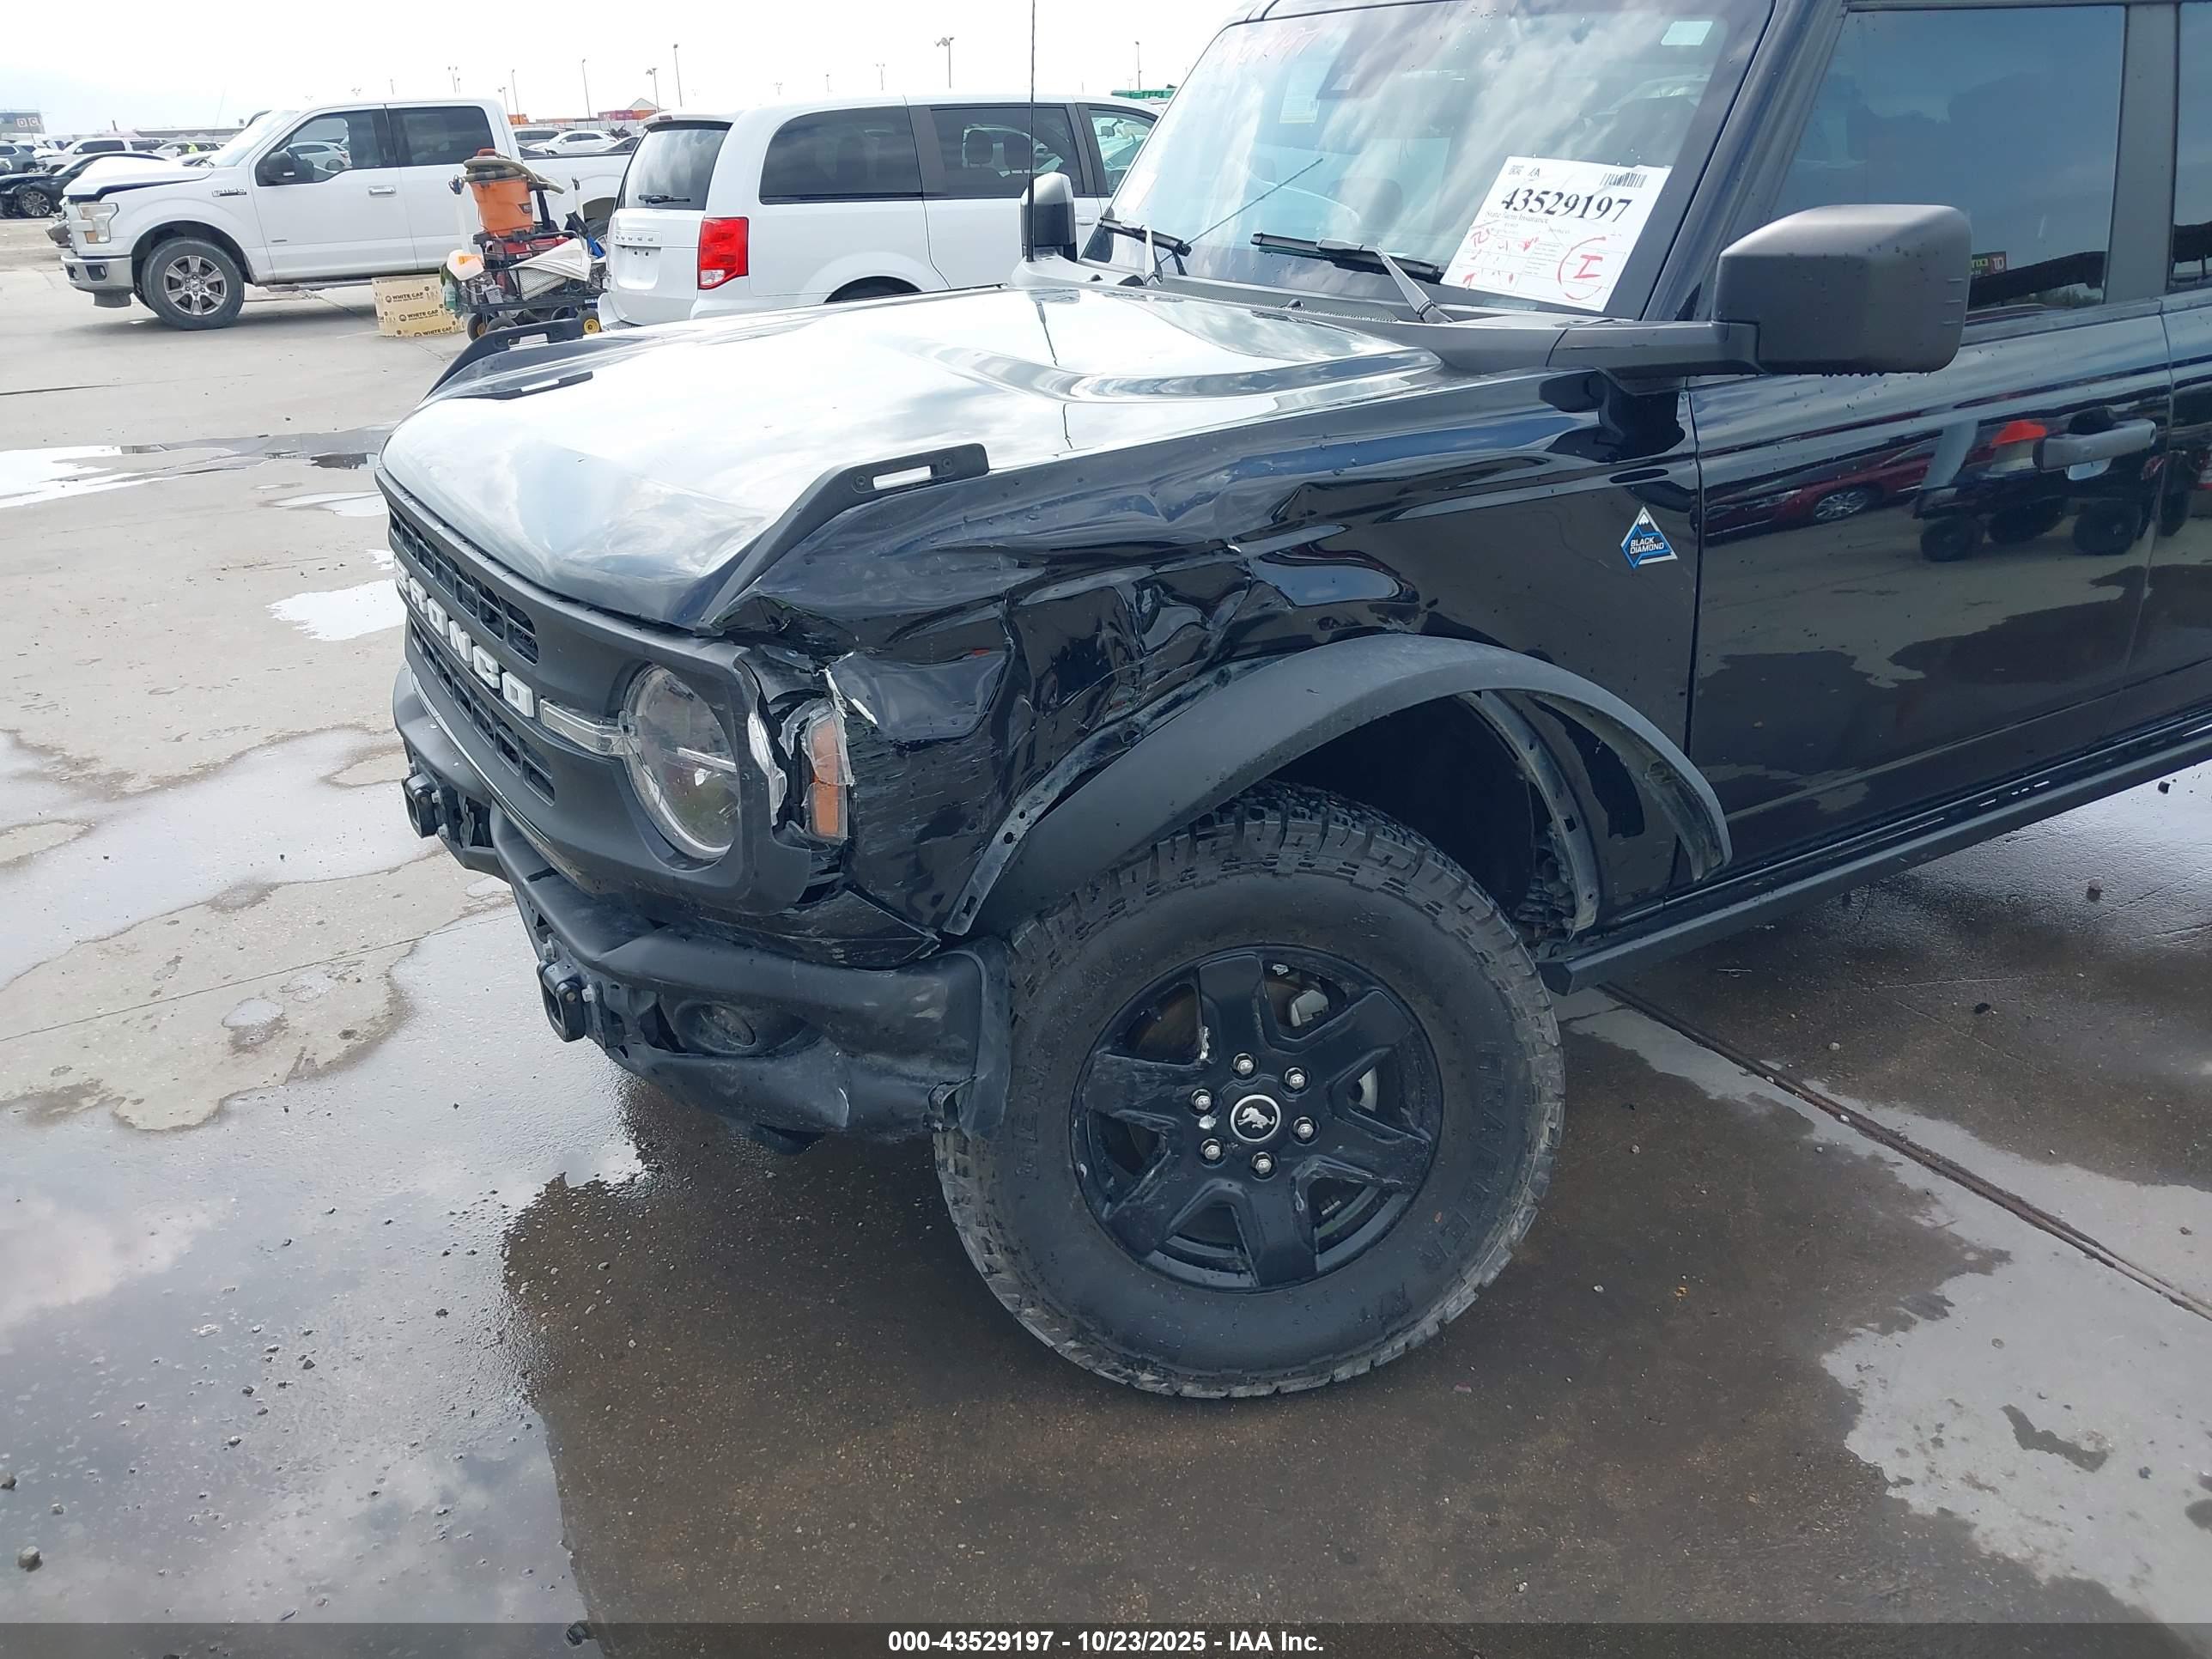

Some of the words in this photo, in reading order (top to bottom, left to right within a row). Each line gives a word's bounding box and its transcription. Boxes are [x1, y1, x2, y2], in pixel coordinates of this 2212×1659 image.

[1501, 187, 1633, 222] 43529197
[1630, 542, 1664, 555] DIAMOND
[1631, 536, 1655, 547] BLACK
[394, 557, 535, 719] BRONCO
